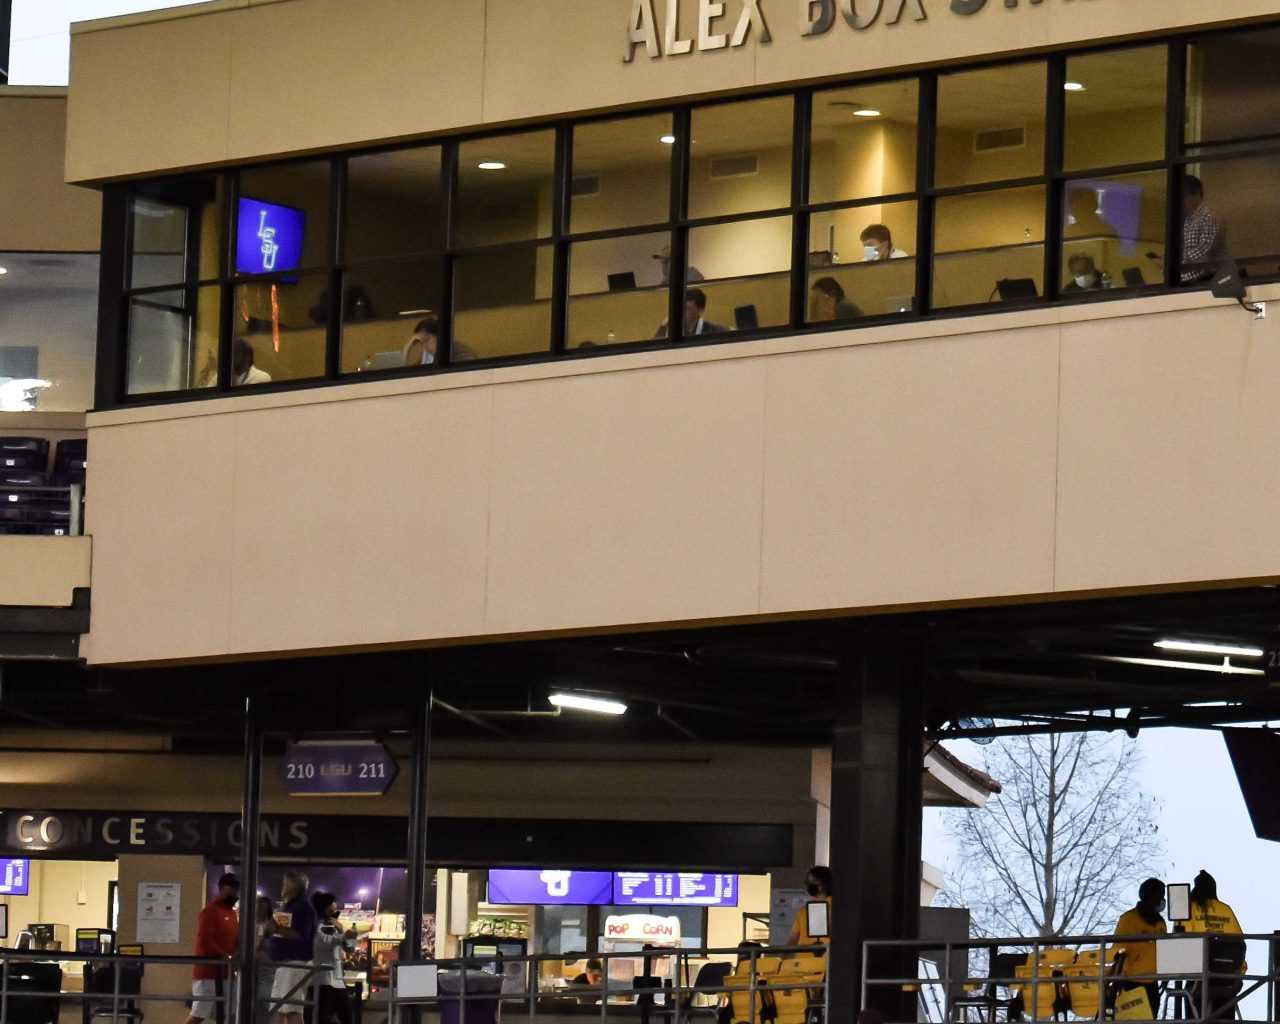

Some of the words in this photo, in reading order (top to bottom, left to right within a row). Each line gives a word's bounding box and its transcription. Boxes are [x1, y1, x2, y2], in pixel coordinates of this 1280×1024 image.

[287, 763, 315, 779] 210
[359, 763, 385, 778] 211
[16, 815, 309, 849] CONCESSIONS
[608, 923, 629, 935] POP
[643, 922, 672, 936] CORN
